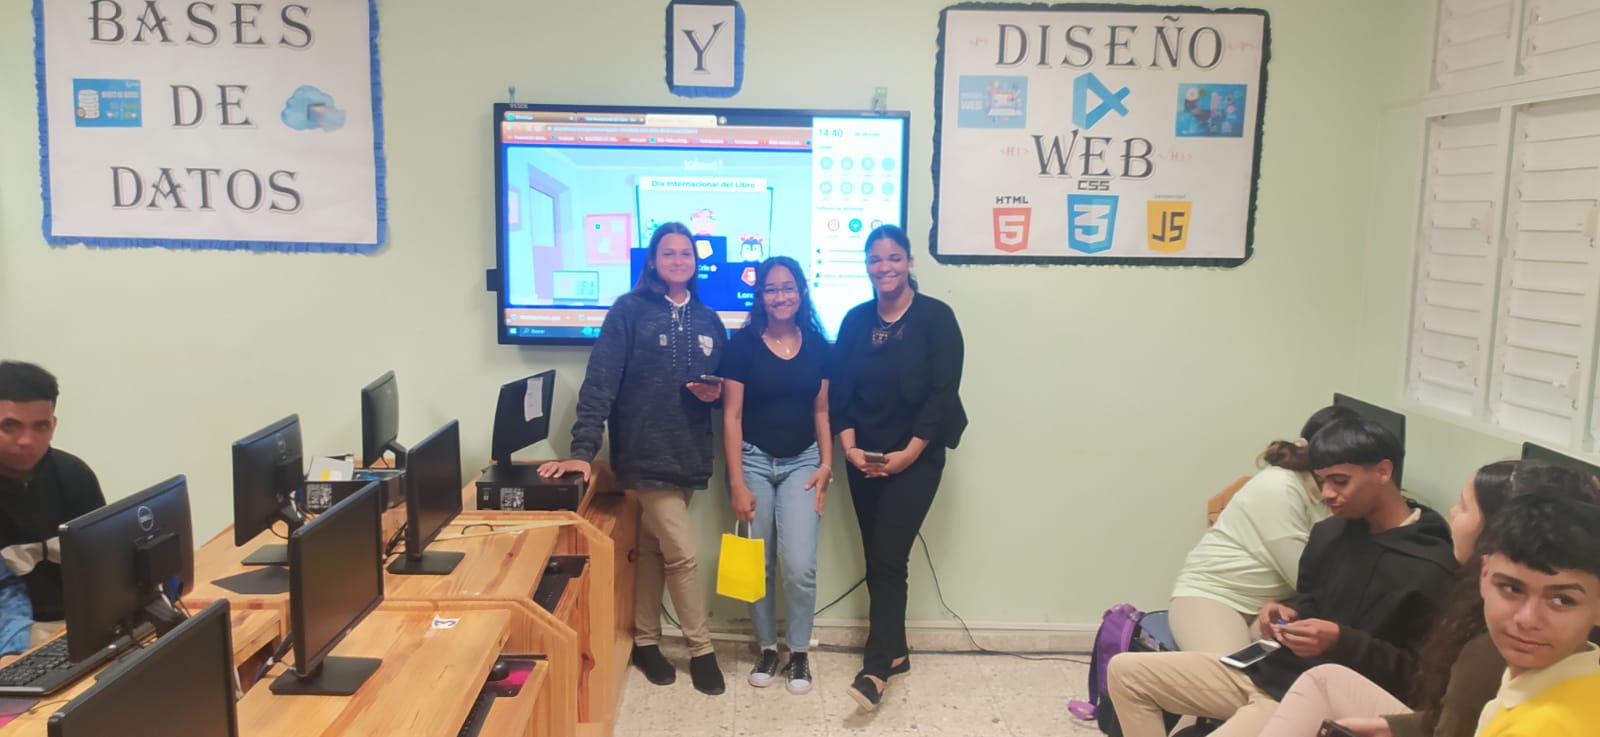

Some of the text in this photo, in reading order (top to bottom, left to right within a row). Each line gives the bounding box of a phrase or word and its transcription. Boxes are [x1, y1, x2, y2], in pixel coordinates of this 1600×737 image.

[88, 0, 313, 48] BASES
[681, 20, 727, 73] Y
[995, 15, 1223, 70] DISEÑO
[169, 83, 254, 128] DE
[819, 129, 843, 138] 1440
[1031, 129, 1153, 179] WEB
[110, 165, 303, 213] DATOS
[667, 180, 719, 189] Internacional
[721, 181, 734, 189] del
[736, 181, 756, 190] Libro
[995, 195, 1029, 205] HTML
[1077, 180, 1110, 191] CSS
[1152, 211, 1185, 243] JS
